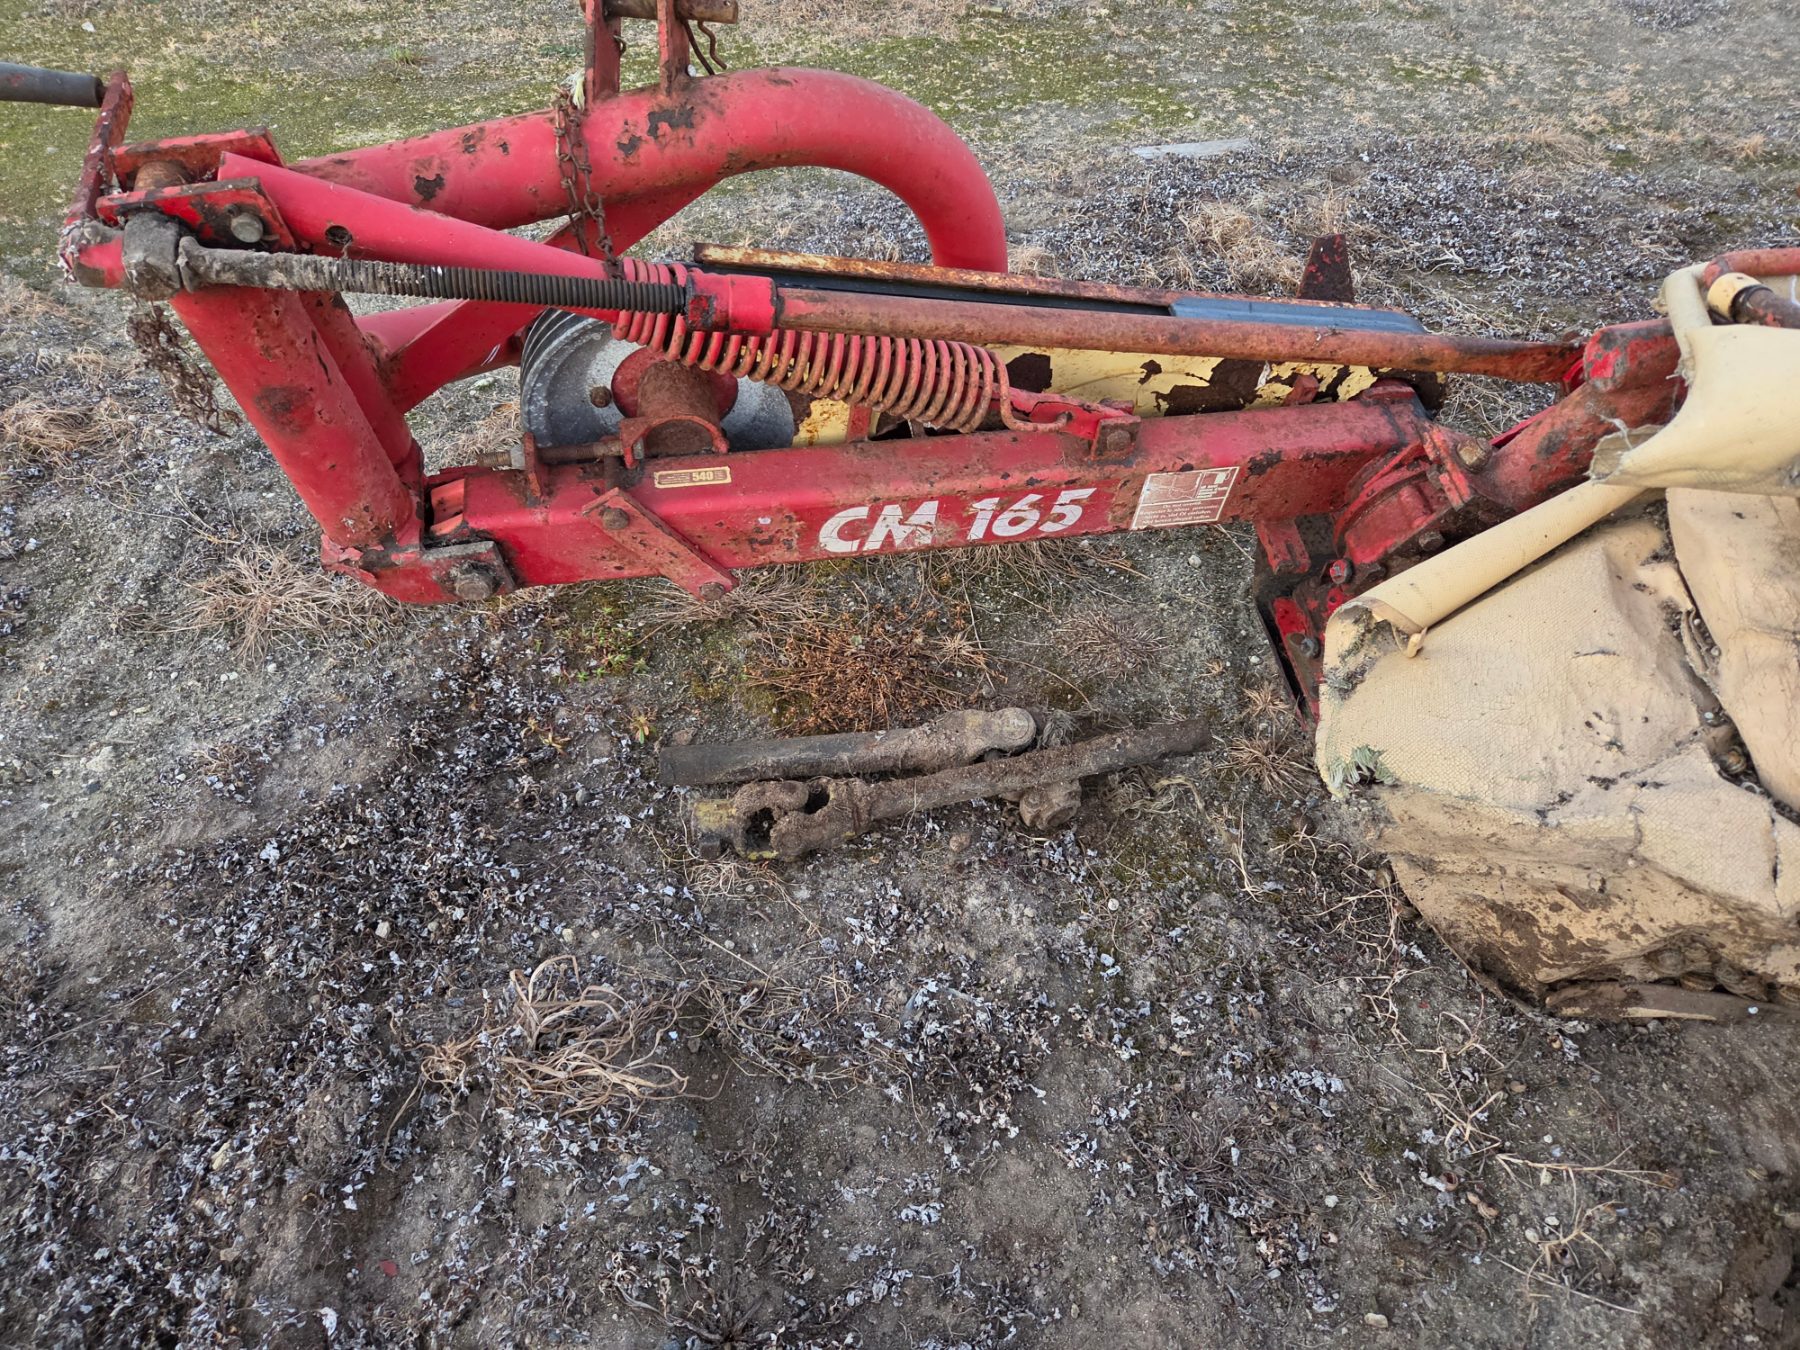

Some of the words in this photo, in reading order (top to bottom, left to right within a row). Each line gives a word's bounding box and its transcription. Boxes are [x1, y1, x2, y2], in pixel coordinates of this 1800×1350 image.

[692, 471, 714, 481] 540
[818, 500, 939, 552] CM
[966, 487, 1097, 541] 165
